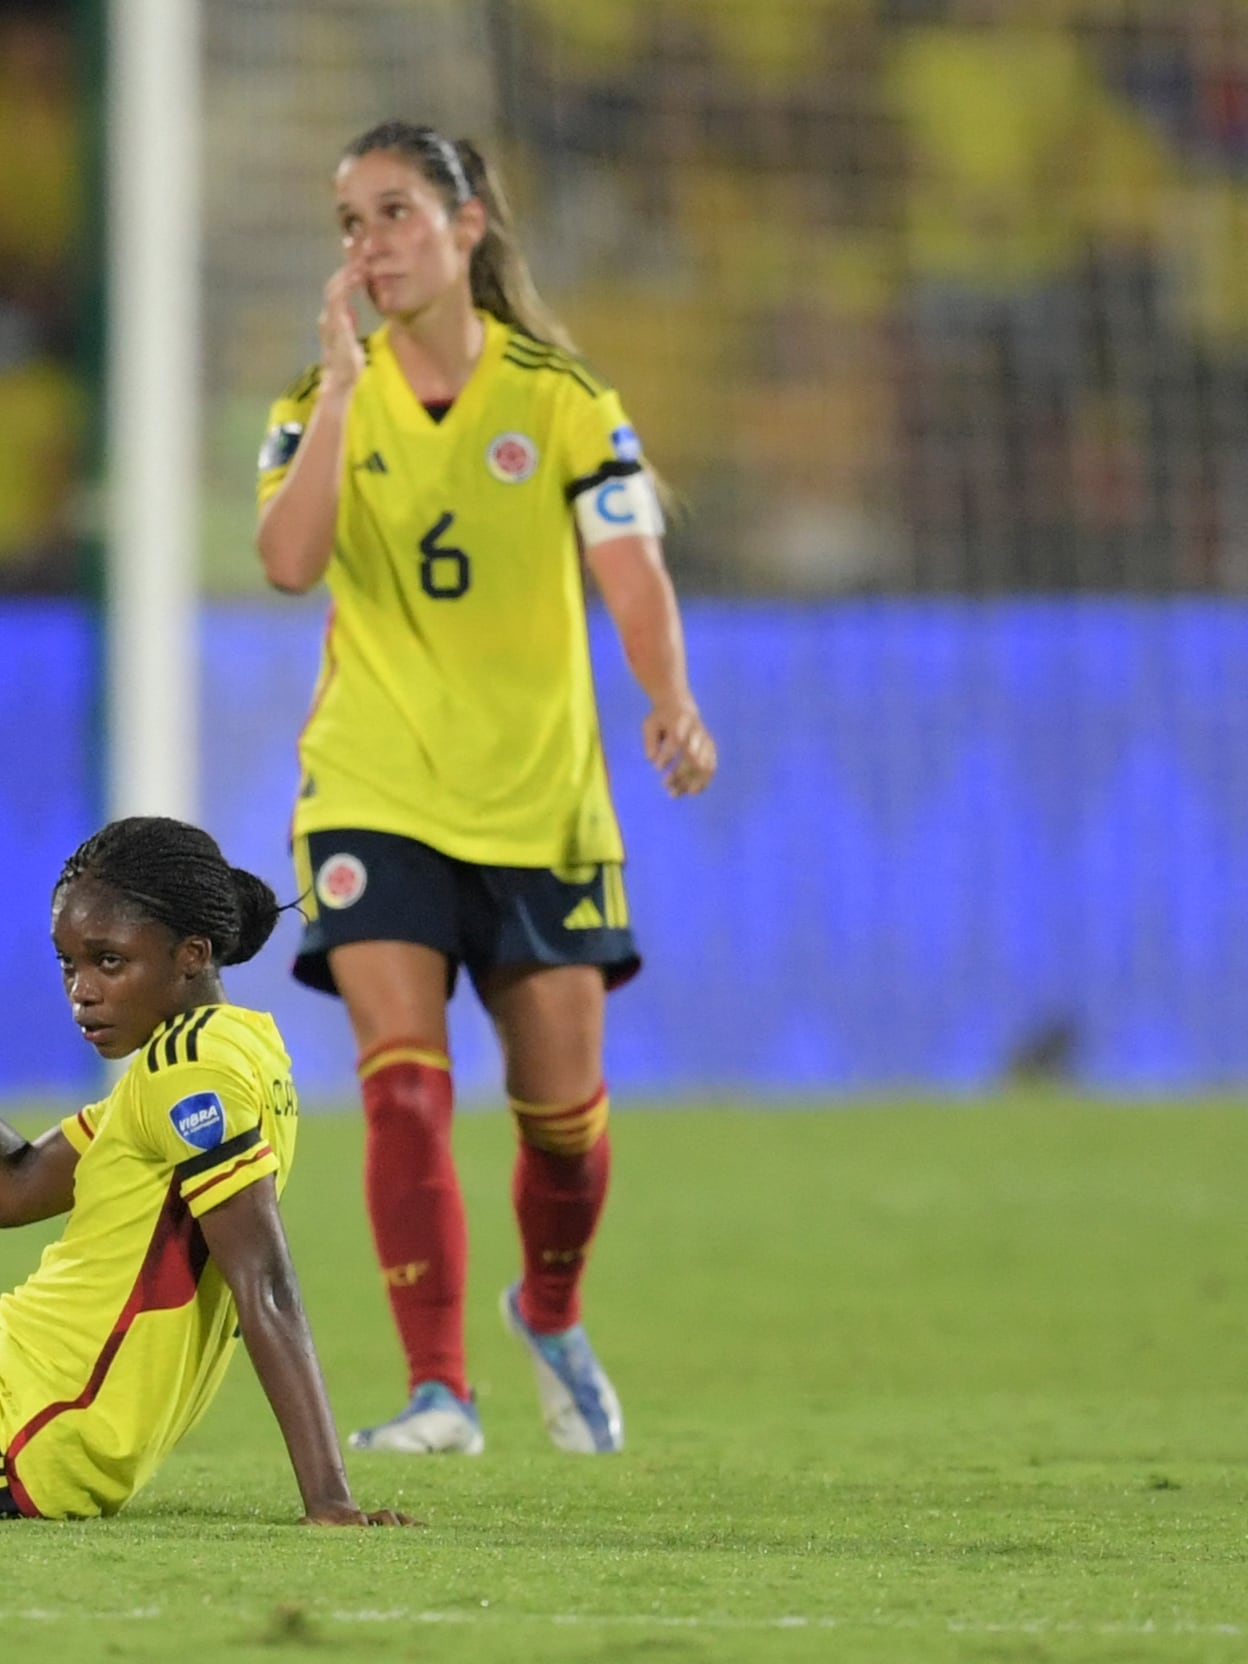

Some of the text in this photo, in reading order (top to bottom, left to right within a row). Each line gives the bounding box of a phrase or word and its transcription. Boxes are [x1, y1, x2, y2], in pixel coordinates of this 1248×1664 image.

[595, 483, 636, 525] C
[419, 511, 470, 600] 6
[178, 1104, 219, 1132] VIBRA
